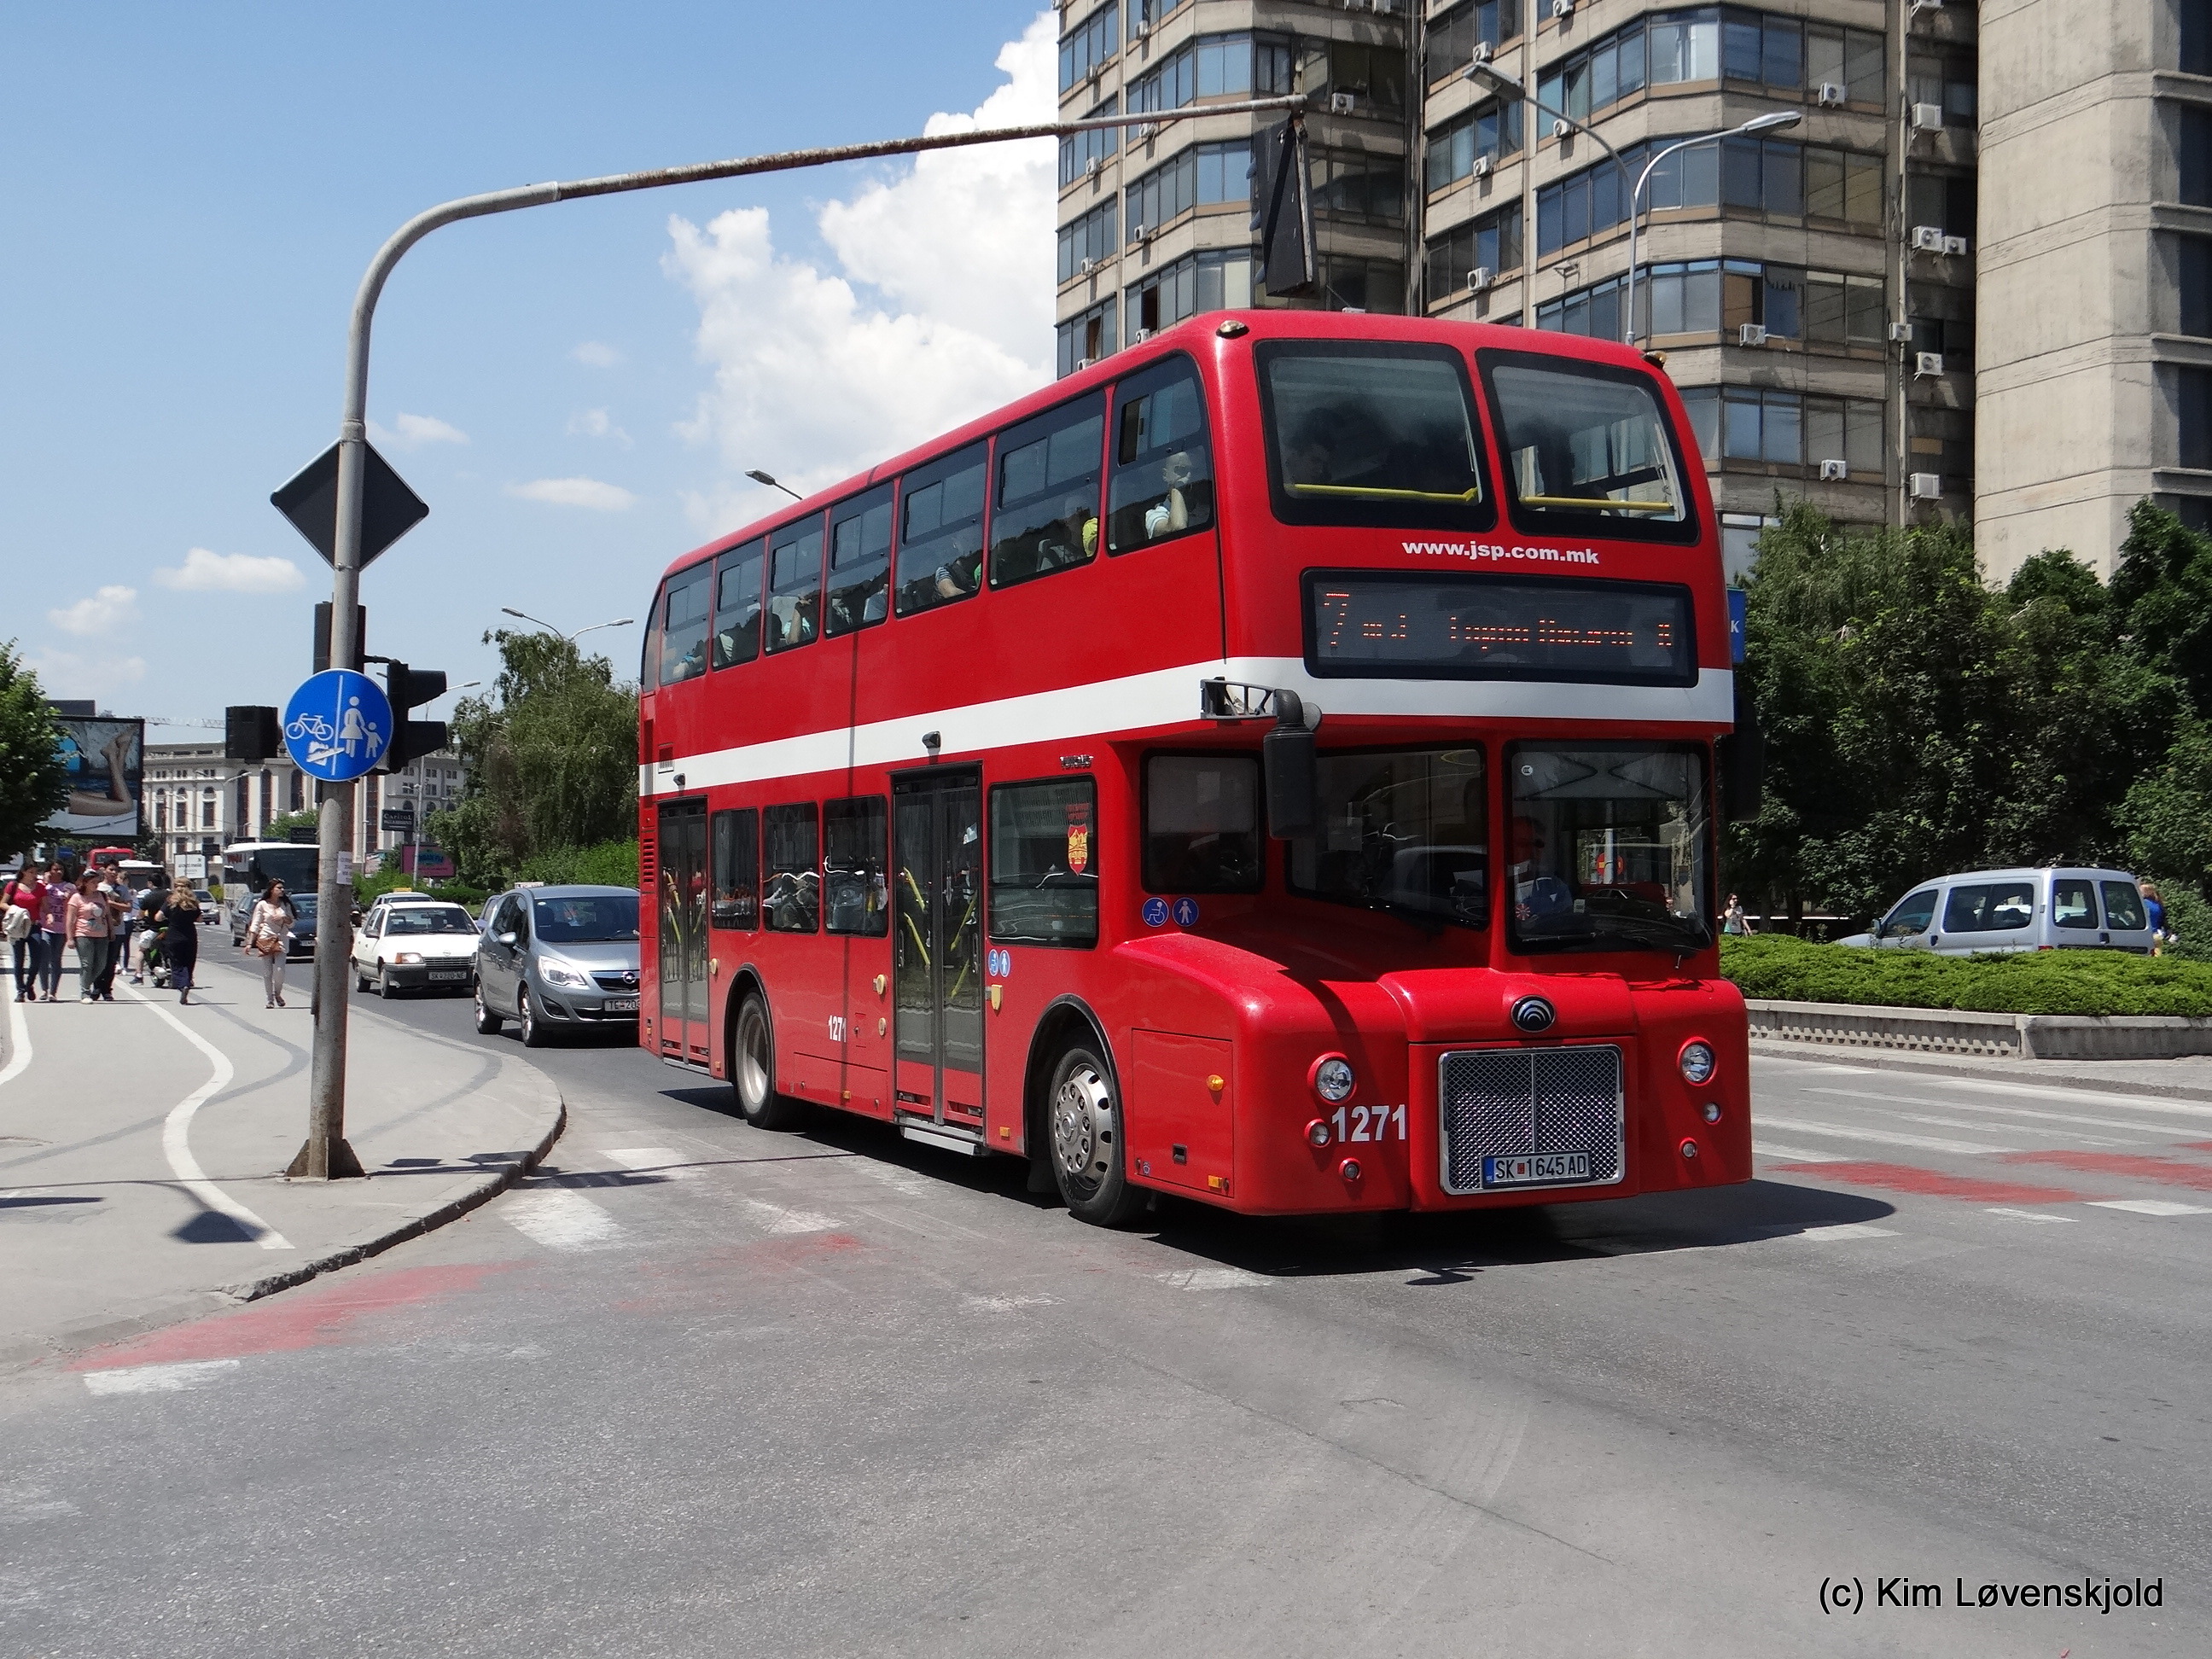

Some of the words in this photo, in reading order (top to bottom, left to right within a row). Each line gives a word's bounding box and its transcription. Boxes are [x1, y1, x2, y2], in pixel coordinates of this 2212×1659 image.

[1402, 540, 1599, 565] www.jsp.com.mk
[828, 1015, 847, 1043] 1271
[1331, 1103, 1406, 1143] 1271
[1495, 1159, 1515, 1179] SK
[1526, 1156, 1565, 1177] 1645
[1568, 1155, 1586, 1174] AD
